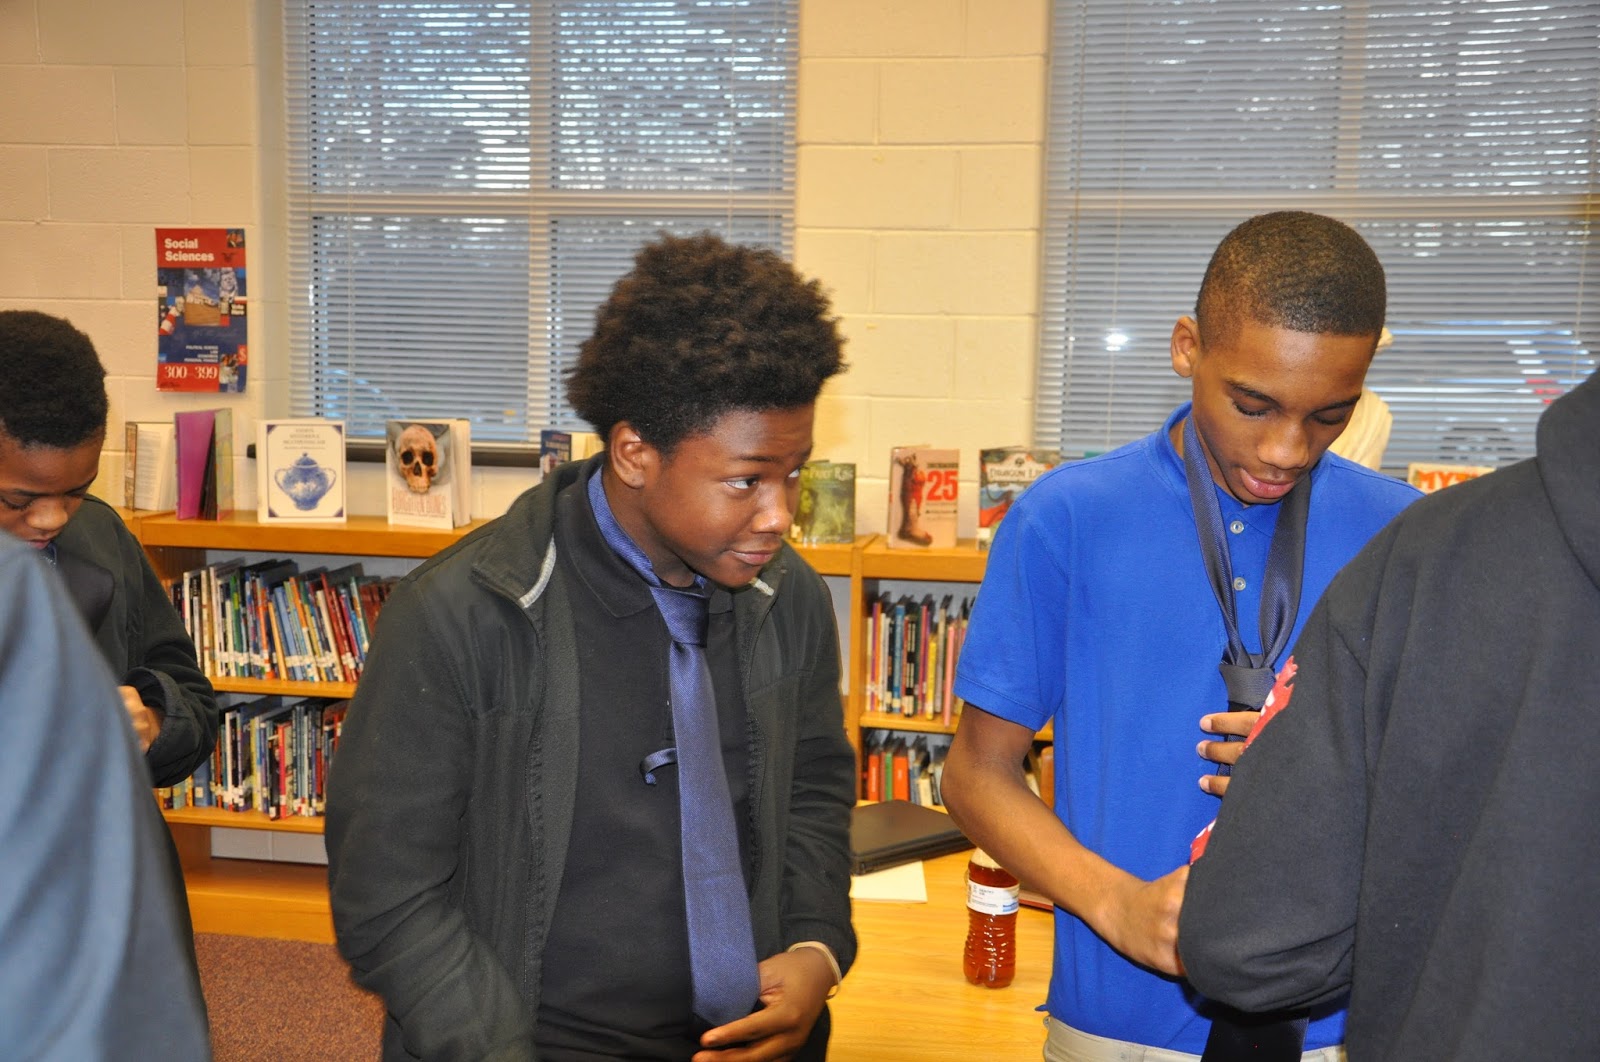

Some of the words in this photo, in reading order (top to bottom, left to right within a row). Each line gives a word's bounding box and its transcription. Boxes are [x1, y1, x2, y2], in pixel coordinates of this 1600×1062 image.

[164, 238, 199, 249] Social
[165, 251, 215, 262] Sciences
[926, 469, 959, 501] 25
